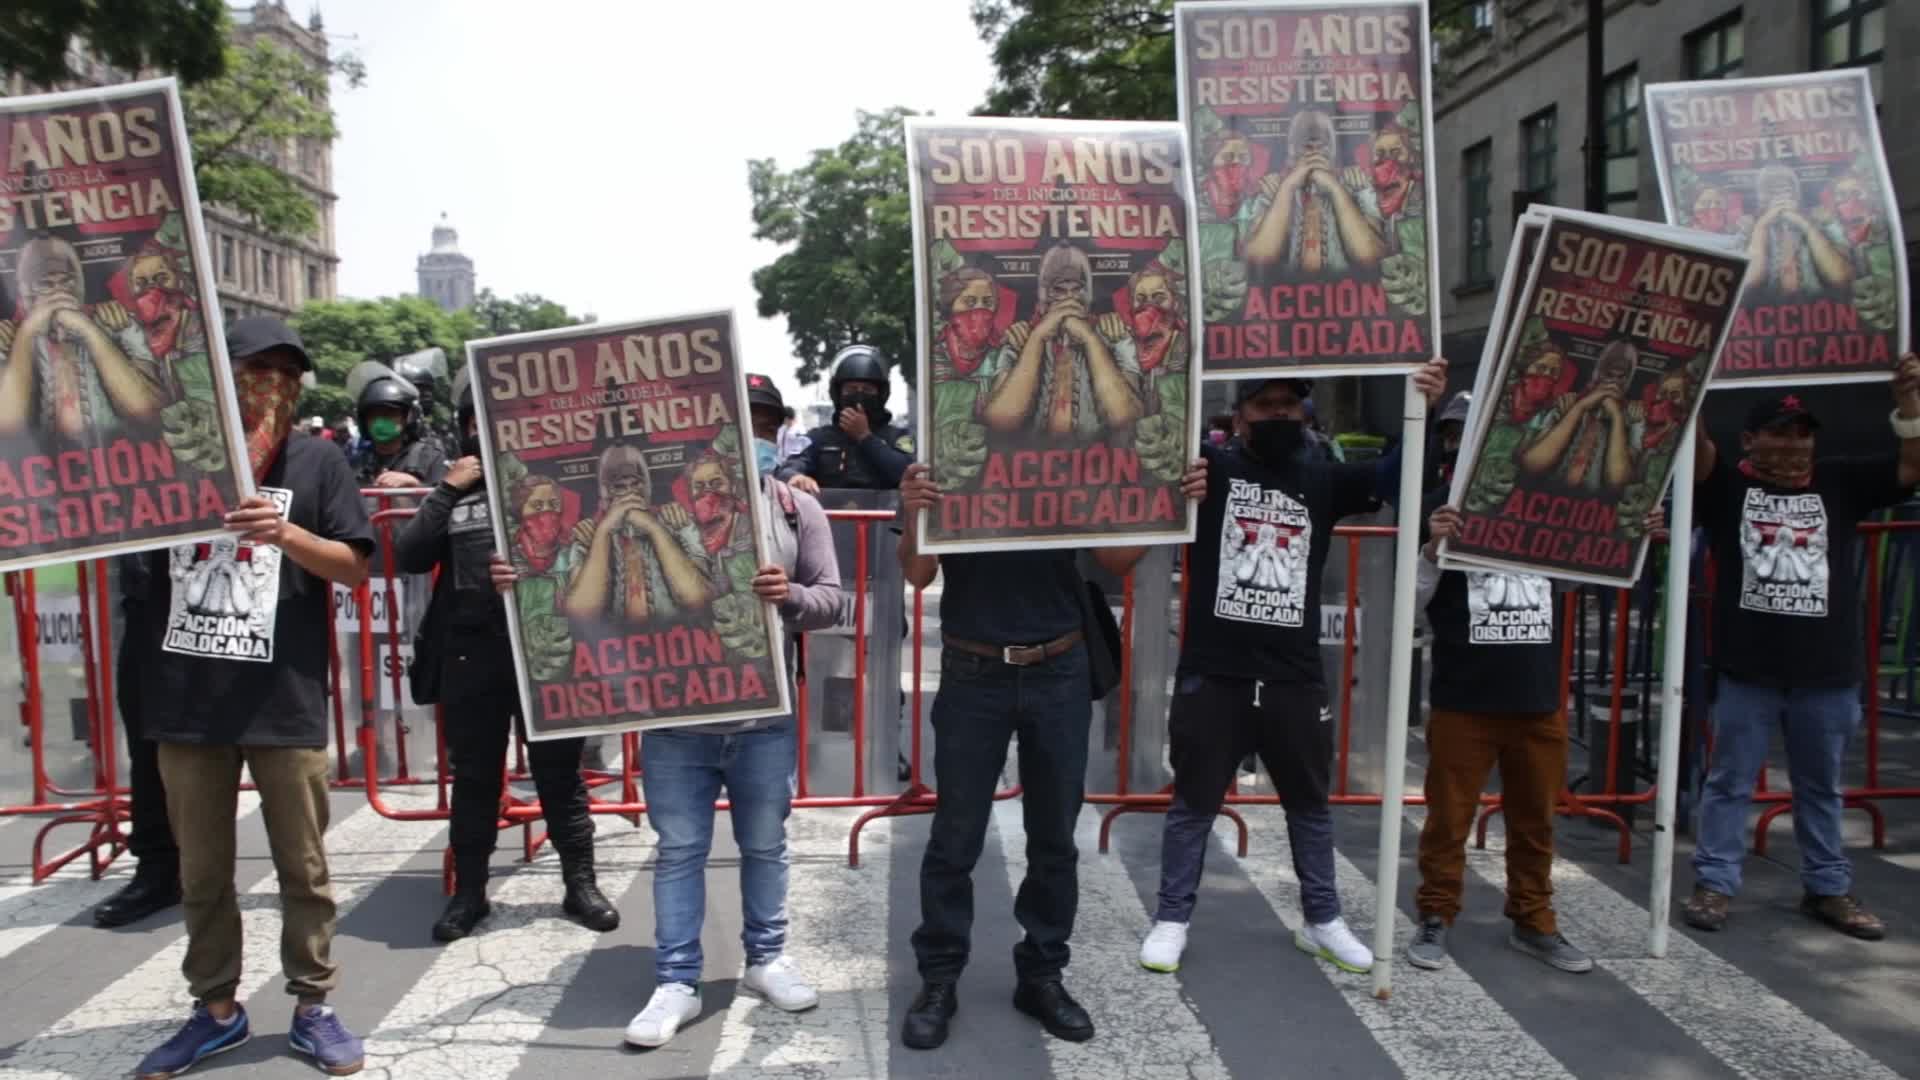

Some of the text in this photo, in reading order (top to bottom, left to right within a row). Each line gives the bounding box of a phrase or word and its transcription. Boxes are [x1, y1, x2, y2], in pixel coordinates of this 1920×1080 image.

[1195, 13, 1411, 60] 500 AÑOS
[1196, 72, 1415, 106] RESISTENCIA
[1664, 94, 1737, 129] 500
[8, 106, 161, 173] AÑOS
[928, 136, 1174, 186] 500 AÑOS
[1671, 129, 1867, 165] RESISTENCIA
[992, 187, 1022, 201] DEL
[1027, 187, 1078, 202] INICIO
[933, 204, 1179, 240] RESISTENCIA
[1550, 231, 1628, 284] 500
[1630, 251, 1733, 307] AÑOS
[1243, 278, 1389, 321] ACCIÓN
[1534, 287, 1713, 350] RESISTENCIA
[1731, 298, 1858, 337] ACCIÓN
[1207, 320, 1424, 361] DISLOCADA
[1718, 334, 1889, 371] ISLOCADA
[487, 328, 723, 402] 500 AÑOS
[496, 393, 733, 452] RESISTENCIA
[0, 438, 175, 500] ACCIÓN
[982, 442, 1142, 490] ACCIÓN
[0, 477, 228, 548] SLOCADA
[941, 486, 1177, 531] DISLOCADA
[1503, 487, 1618, 533] ACCIÓN
[1460, 514, 1632, 570] DISLOCADA
[1219, 599, 1300, 623] DISLOCADA
[1474, 624, 1551, 641] DISLOCADA
[168, 629, 268, 658] DISLOCADA
[572, 624, 726, 679] ACCIÓN
[540, 662, 769, 721] DISLOCADA
